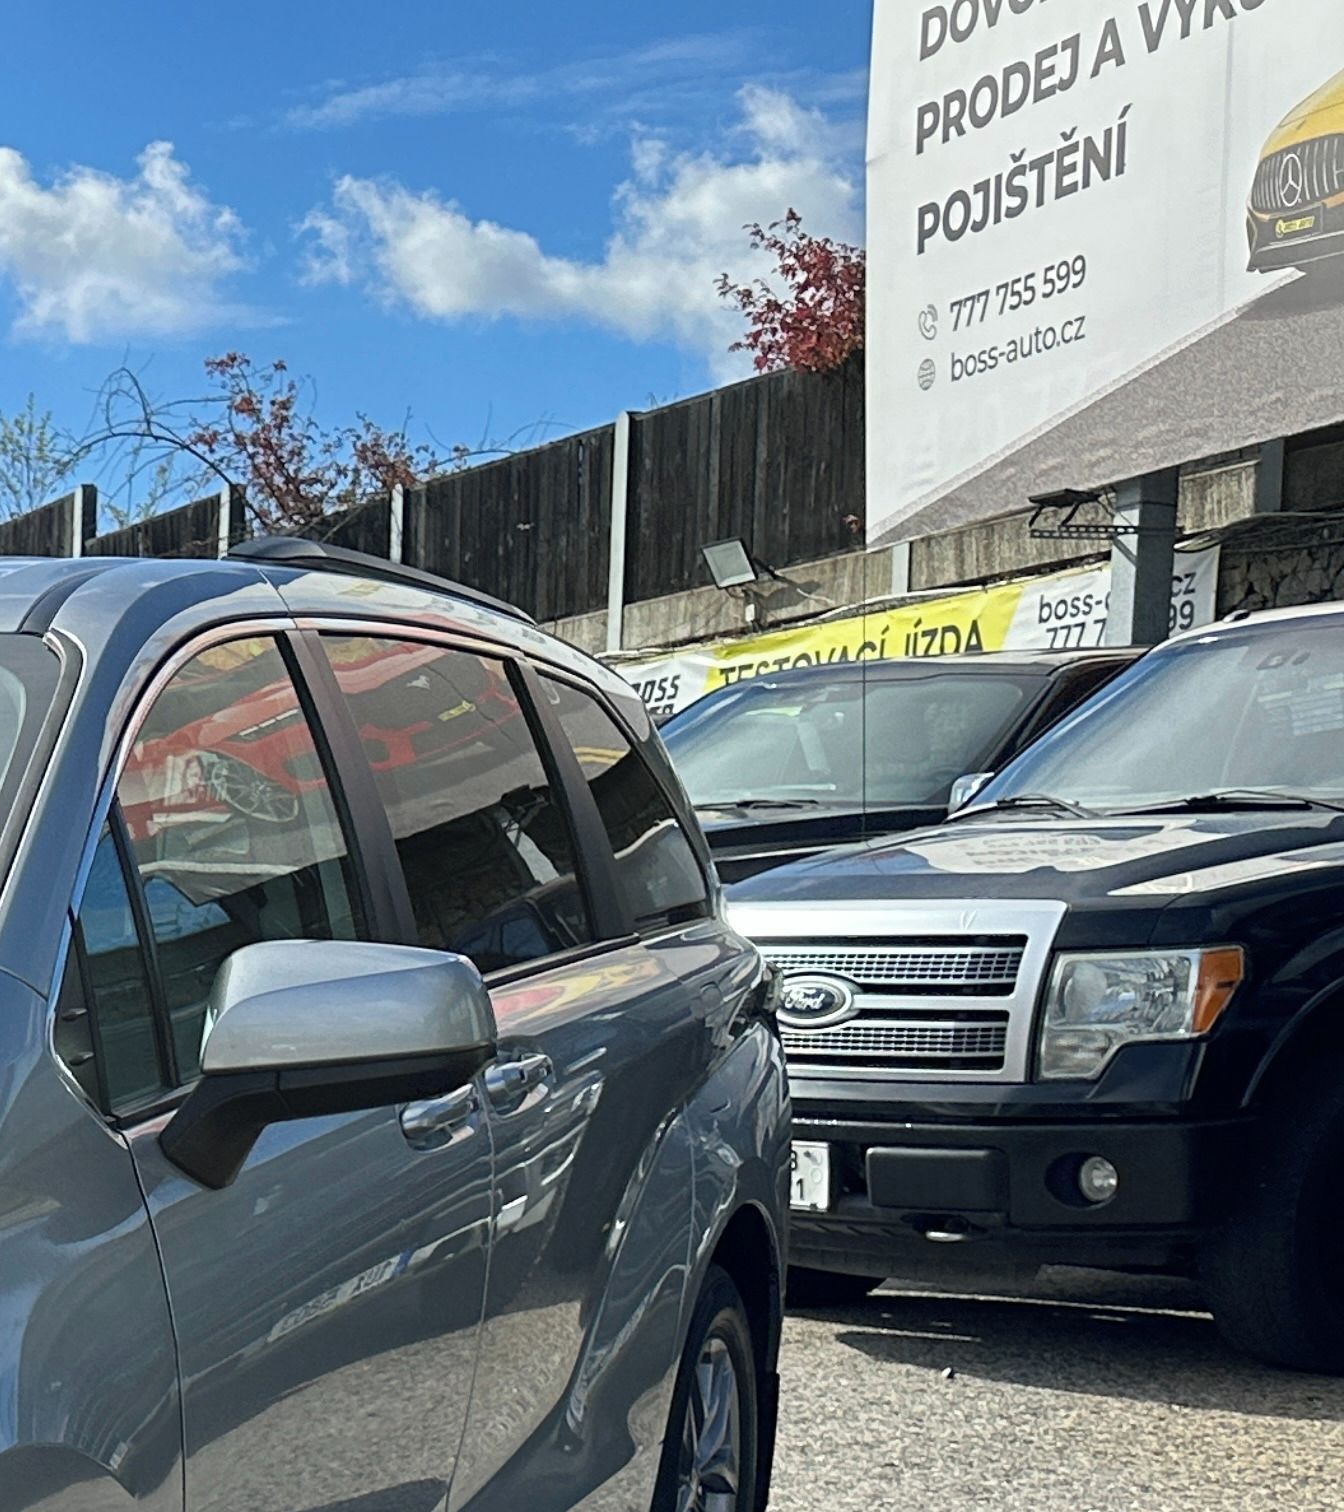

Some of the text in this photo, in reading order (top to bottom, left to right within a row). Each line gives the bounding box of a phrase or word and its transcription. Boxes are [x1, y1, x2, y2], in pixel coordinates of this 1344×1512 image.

[915, 33, 1081, 155] PRODEJ
[1090, 18, 1127, 80] A
[916, 103, 1133, 255] POJIŠTĚNÍ
[949, 254, 1087, 332] 777 755 599
[950, 315, 1087, 382] boss-auto.cz
